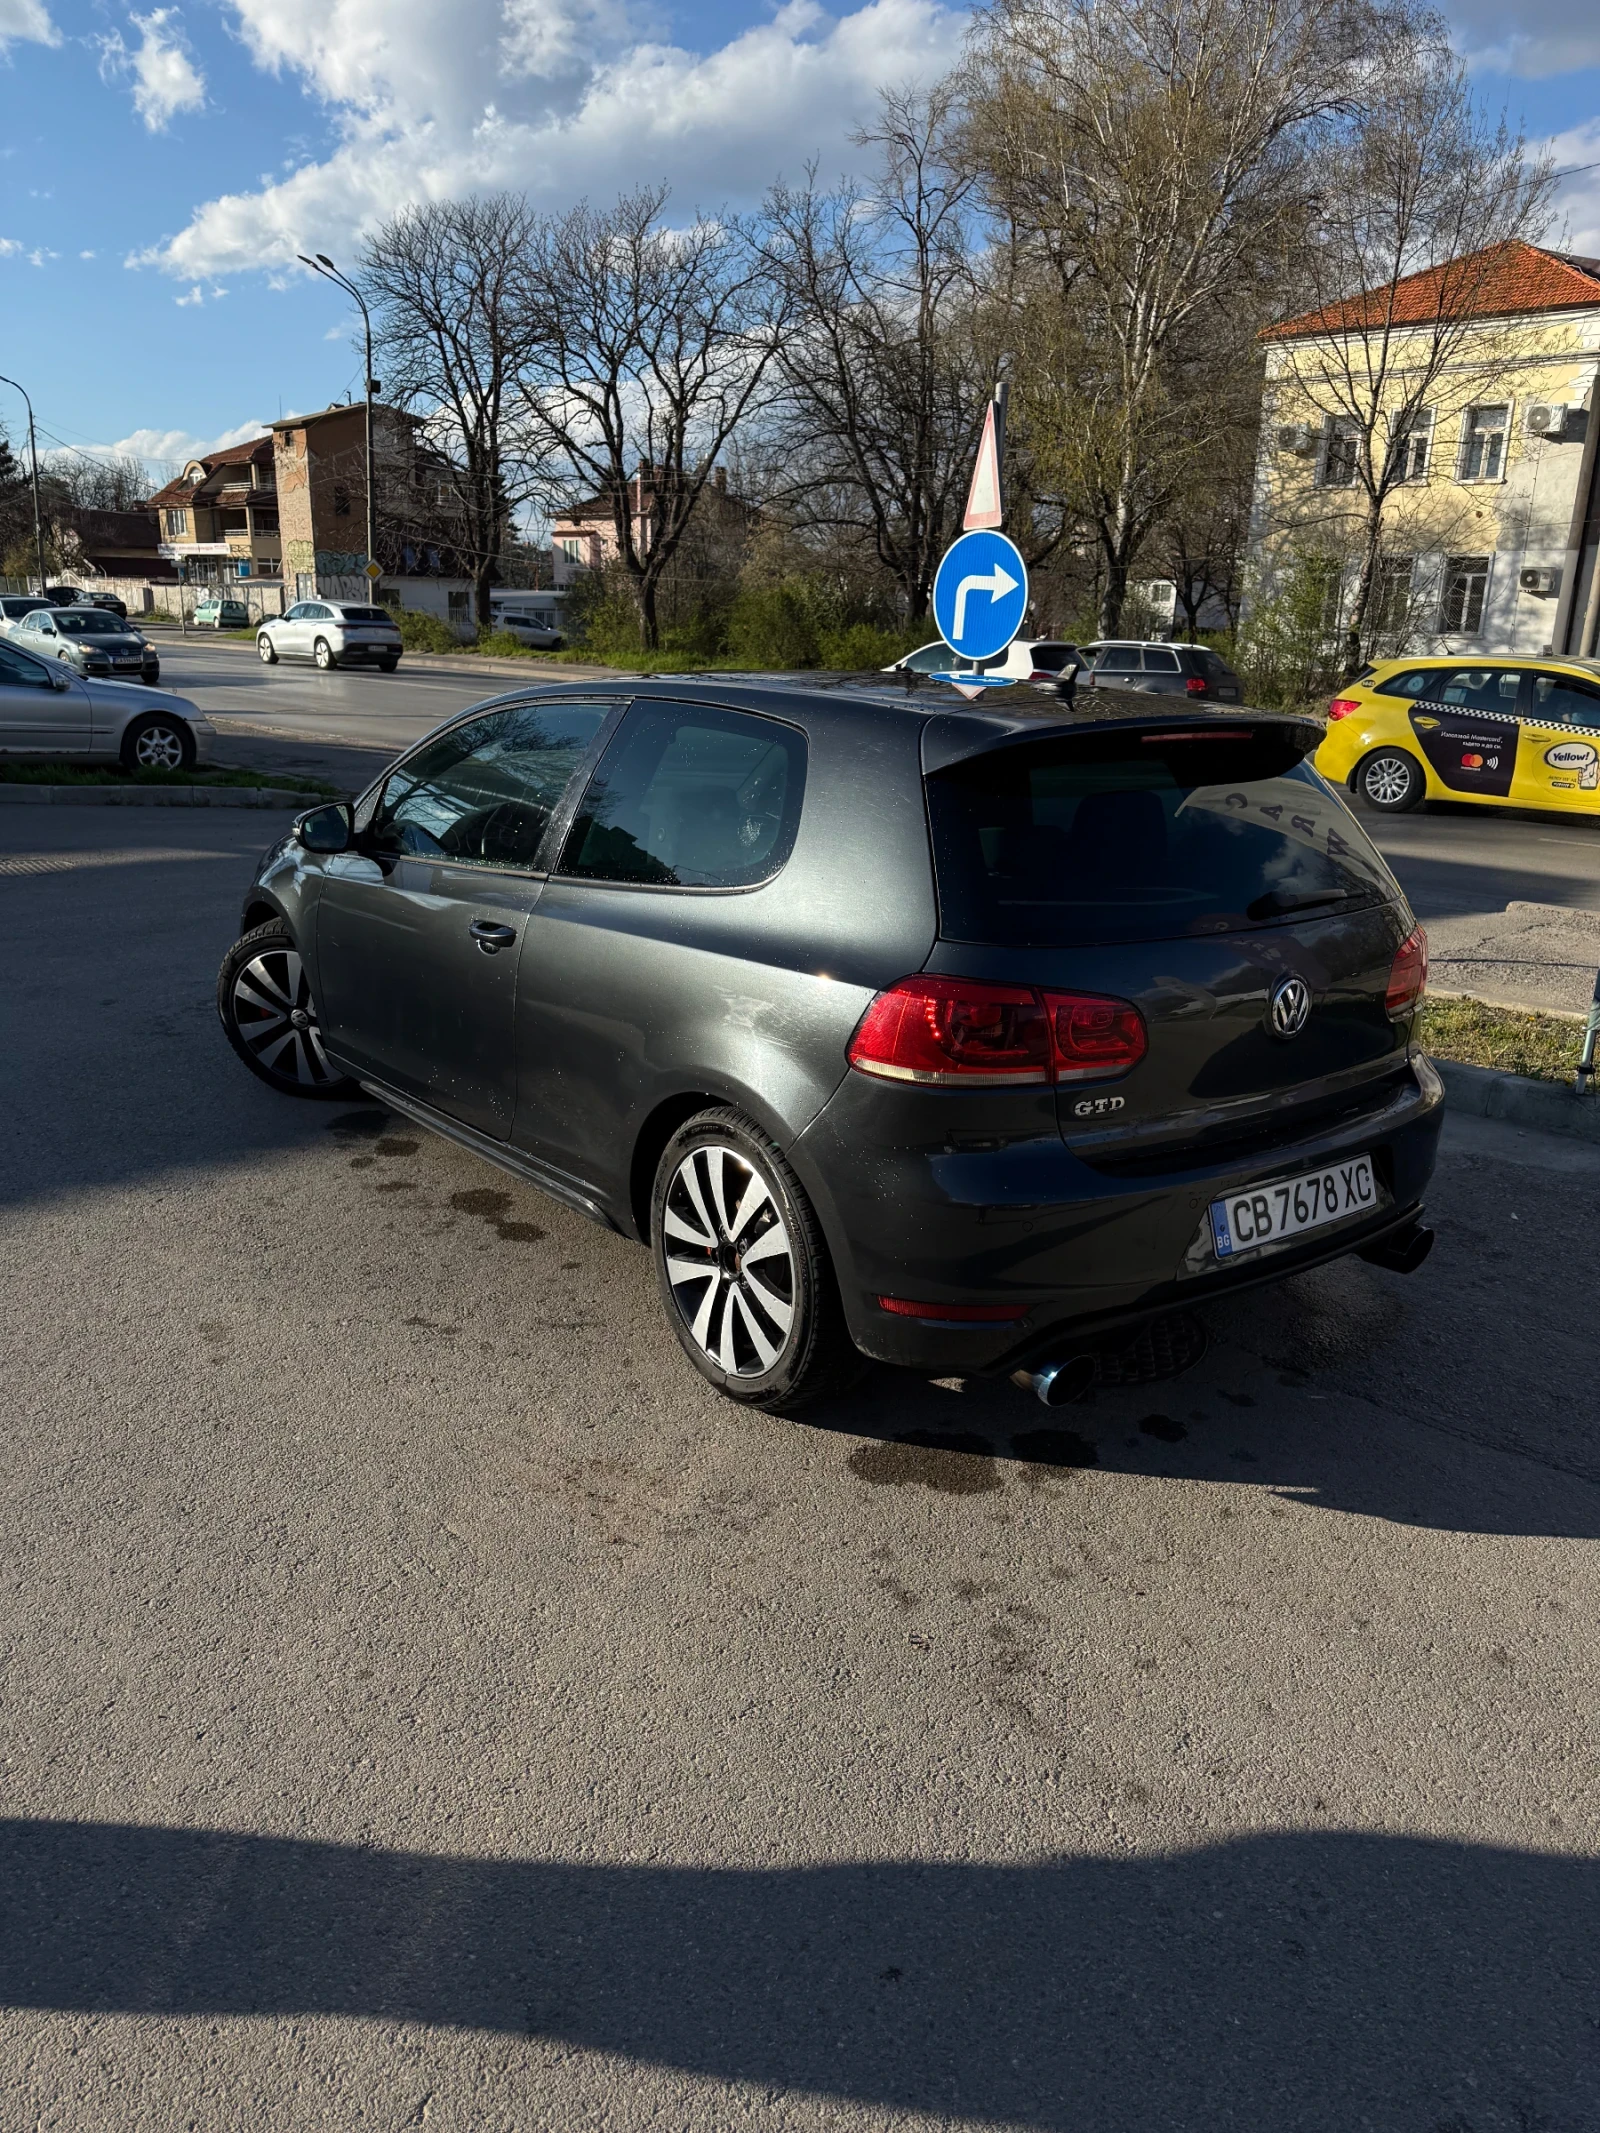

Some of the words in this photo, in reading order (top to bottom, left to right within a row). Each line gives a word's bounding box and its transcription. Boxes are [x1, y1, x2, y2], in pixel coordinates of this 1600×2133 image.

[1553, 751, 1590, 761] Yellow!
[1074, 1096, 1126, 1116] GTD
[1217, 1235, 1230, 1249] BG
